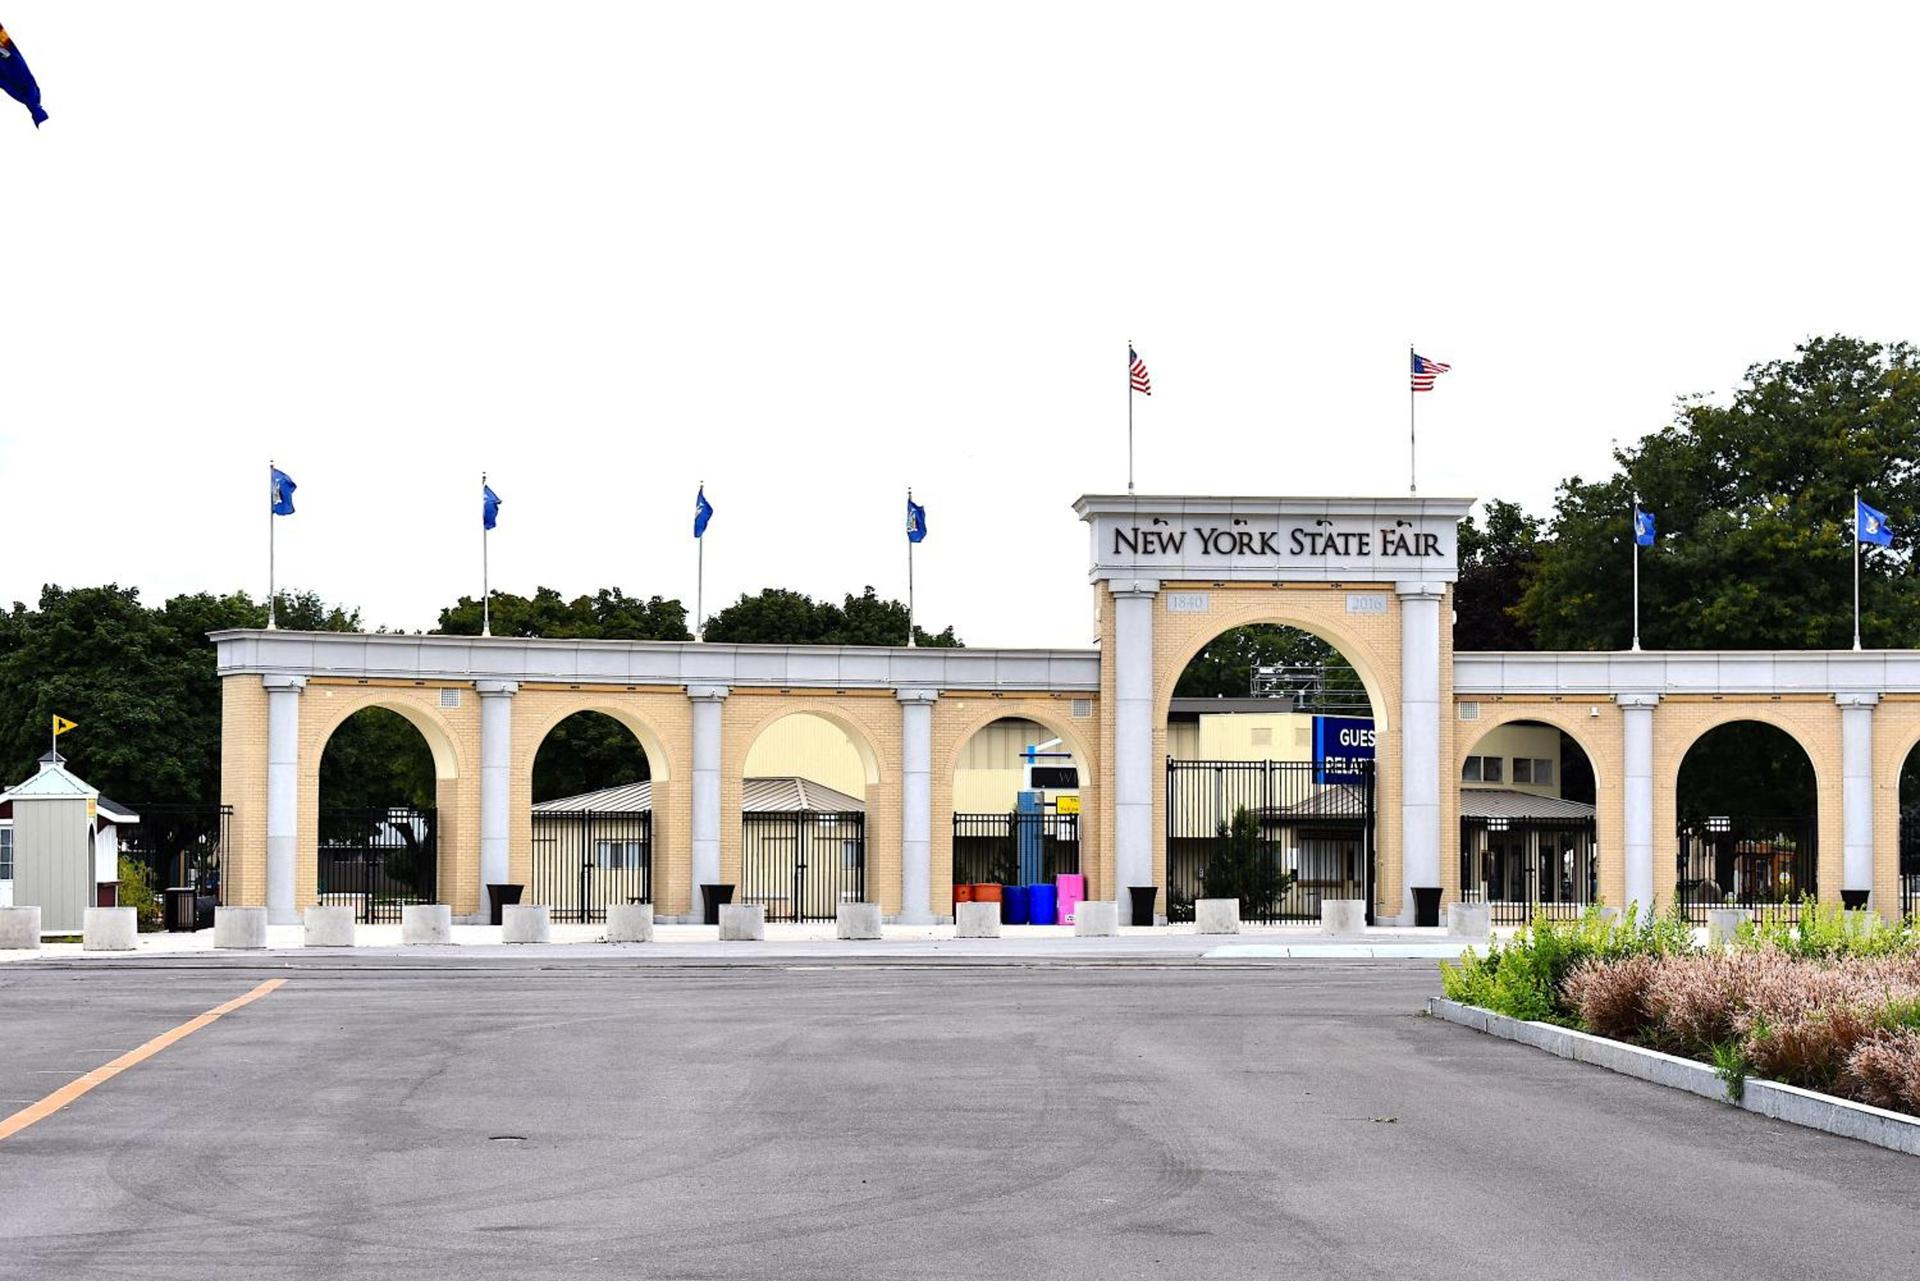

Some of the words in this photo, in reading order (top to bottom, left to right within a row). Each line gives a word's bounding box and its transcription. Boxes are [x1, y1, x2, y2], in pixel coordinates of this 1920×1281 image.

[1113, 527, 1187, 555] NEW
[1194, 528, 1281, 555] YORK
[1290, 528, 1371, 556] STATE
[1380, 529, 1444, 556] FAIR
[1174, 595, 1203, 609] 1840
[1325, 756, 1376, 775] RELAT
